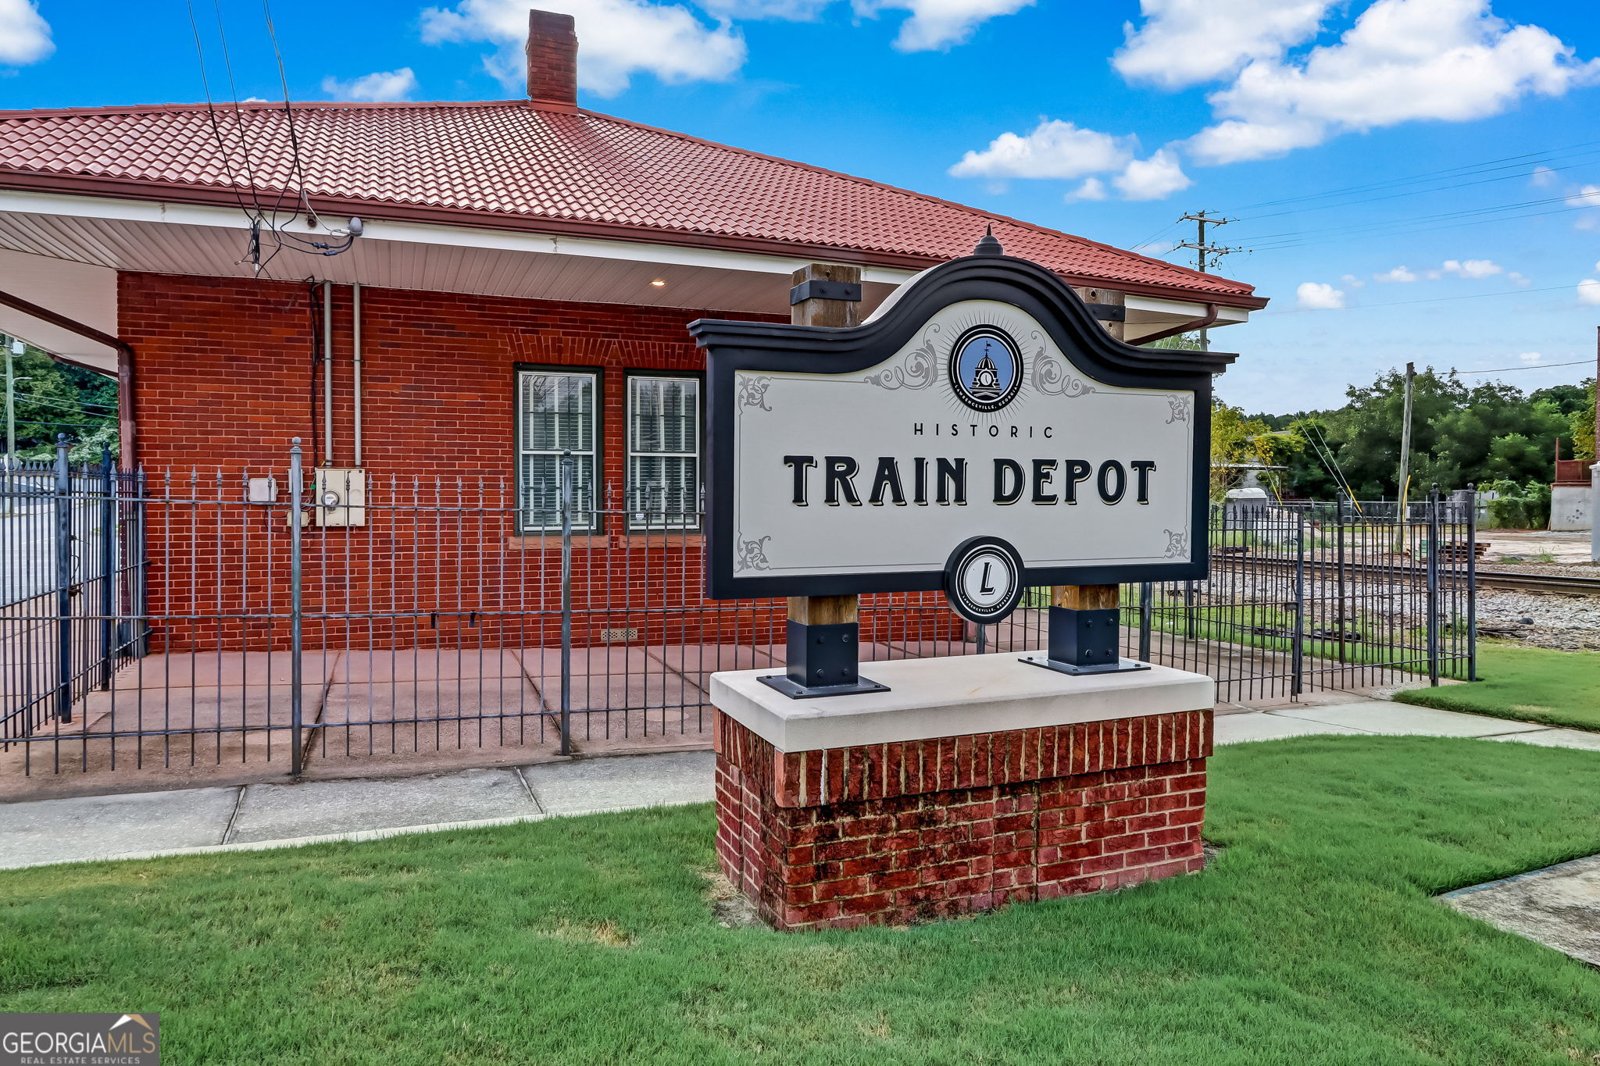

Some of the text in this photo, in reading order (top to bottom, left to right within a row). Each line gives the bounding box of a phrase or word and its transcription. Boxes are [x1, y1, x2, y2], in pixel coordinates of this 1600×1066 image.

[913, 422, 1053, 439] HISTORIC
[783, 455, 1157, 507] TRAIN DEPOT
[980, 562, 996, 595] L
